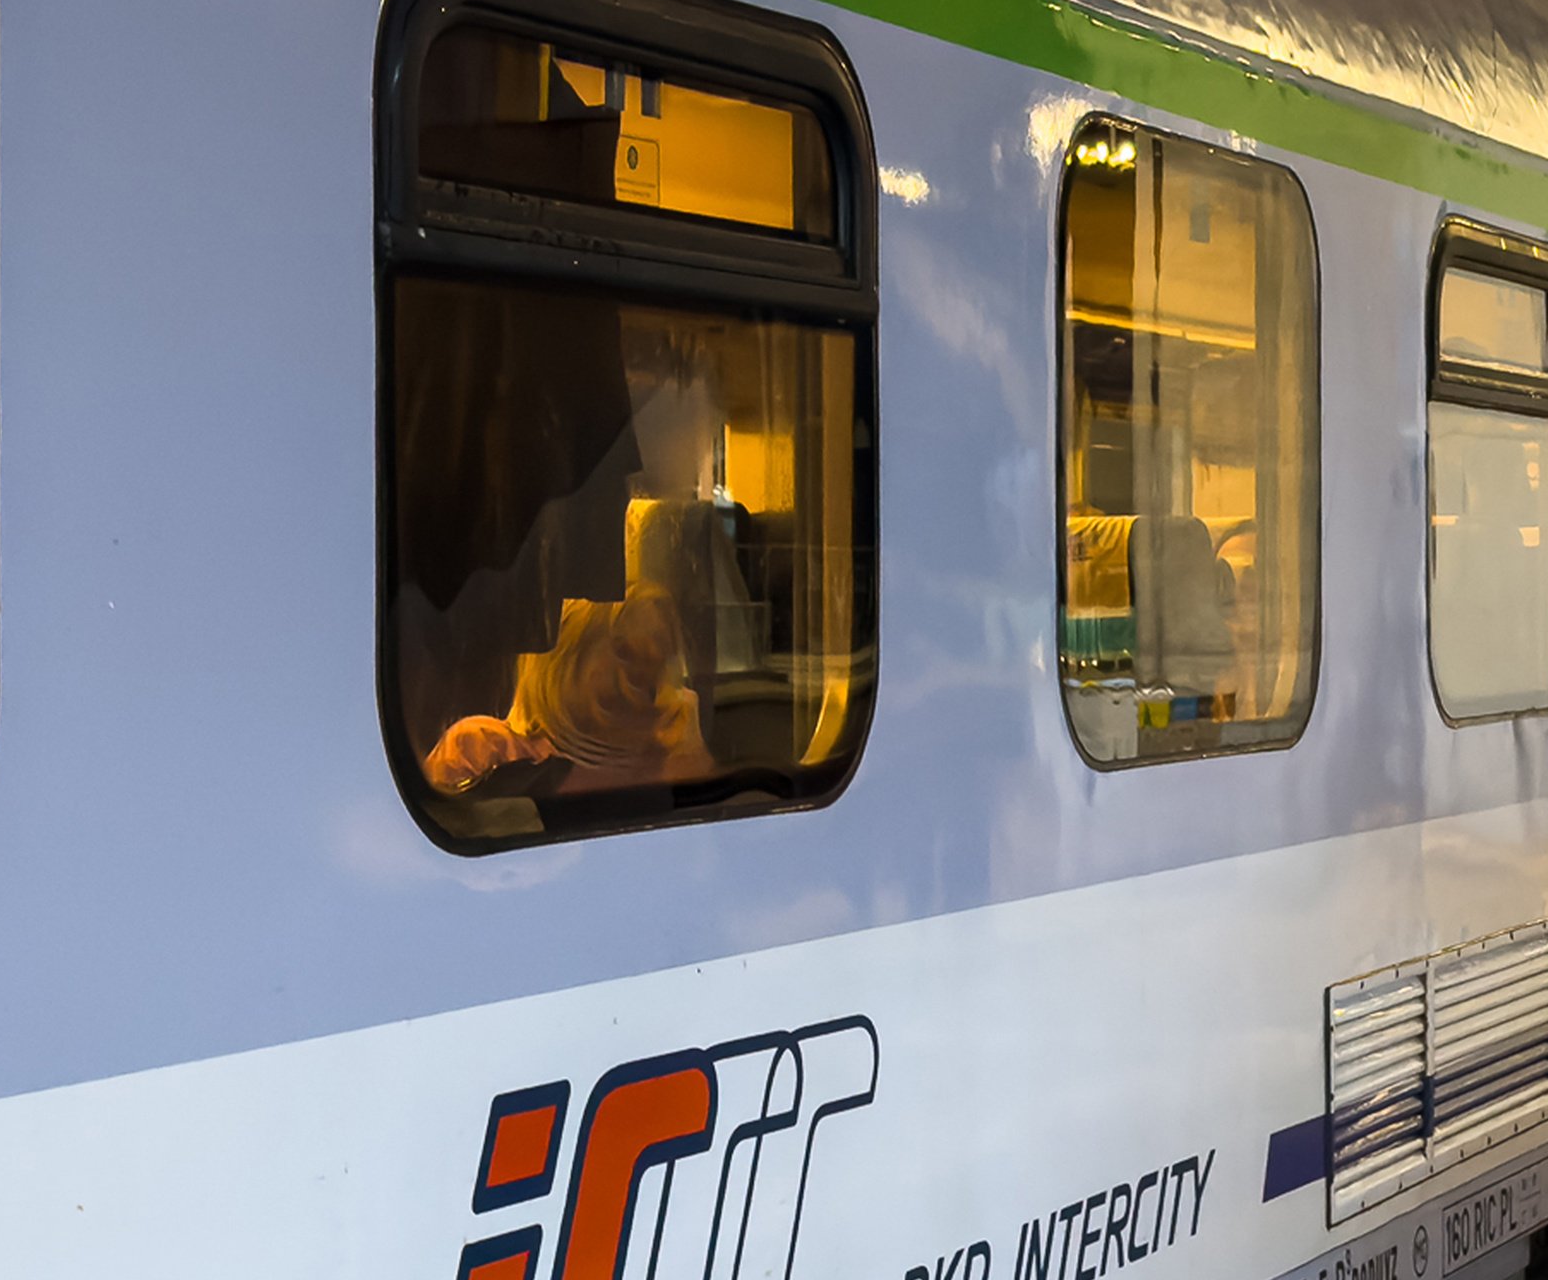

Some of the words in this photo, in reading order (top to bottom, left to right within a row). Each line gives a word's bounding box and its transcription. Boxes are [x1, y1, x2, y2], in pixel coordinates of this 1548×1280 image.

[1446, 1206, 1470, 1266] 160
[1474, 1194, 1497, 1251] RIC
[1499, 1185, 1519, 1237] PL
